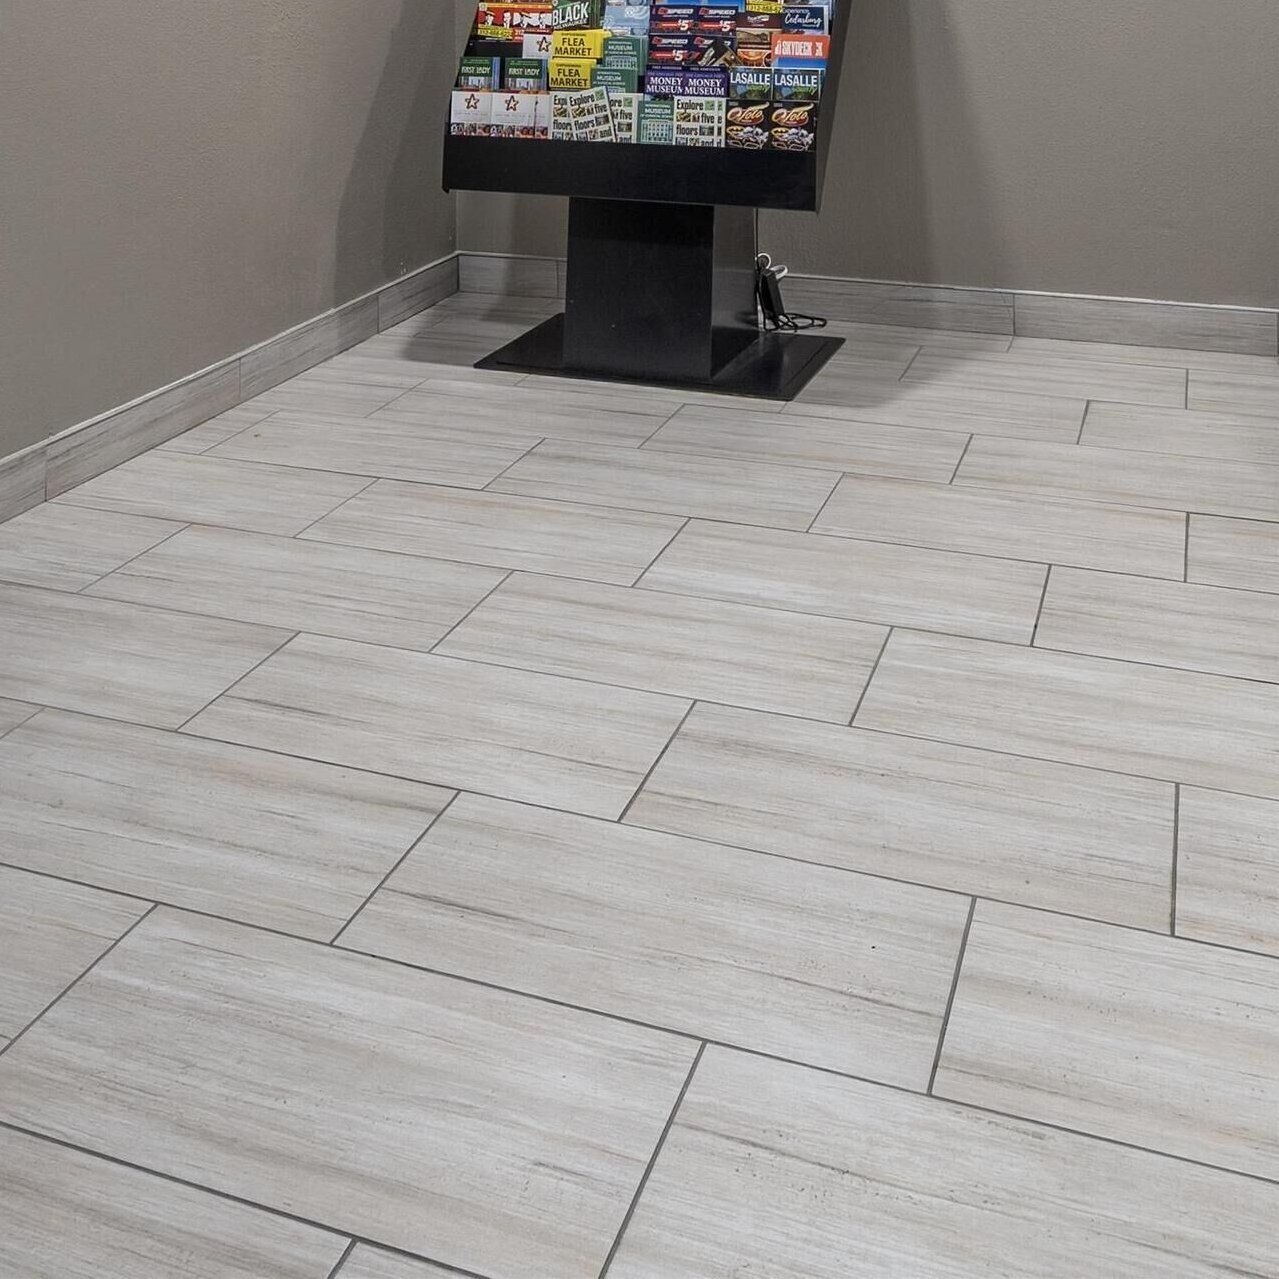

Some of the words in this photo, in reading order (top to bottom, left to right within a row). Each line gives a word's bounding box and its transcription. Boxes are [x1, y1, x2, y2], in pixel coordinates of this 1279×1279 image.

[553, 2, 589, 24] BLACK
[785, 13, 822, 27] Cedarburg
[562, 38, 585, 46] FLEA
[555, 47, 592, 56] MARKET
[782, 42, 812, 56] SKYDECK
[557, 68, 580, 77] FLEA
[551, 78, 588, 86] MARKET
[650, 77, 683, 85] MONEY
[730, 73, 770, 85] LASALLE
[774, 74, 817, 86] LASALLE
[685, 87, 724, 95] MUSEUM
[569, 94, 595, 106] Explore
[677, 99, 704, 111] Explore
[594, 103, 607, 114] five
[620, 109, 632, 120] five
[701, 113, 715, 123] five
[574, 120, 595, 130] floors
[676, 124, 698, 135] floors
[600, 126, 612, 137] and
